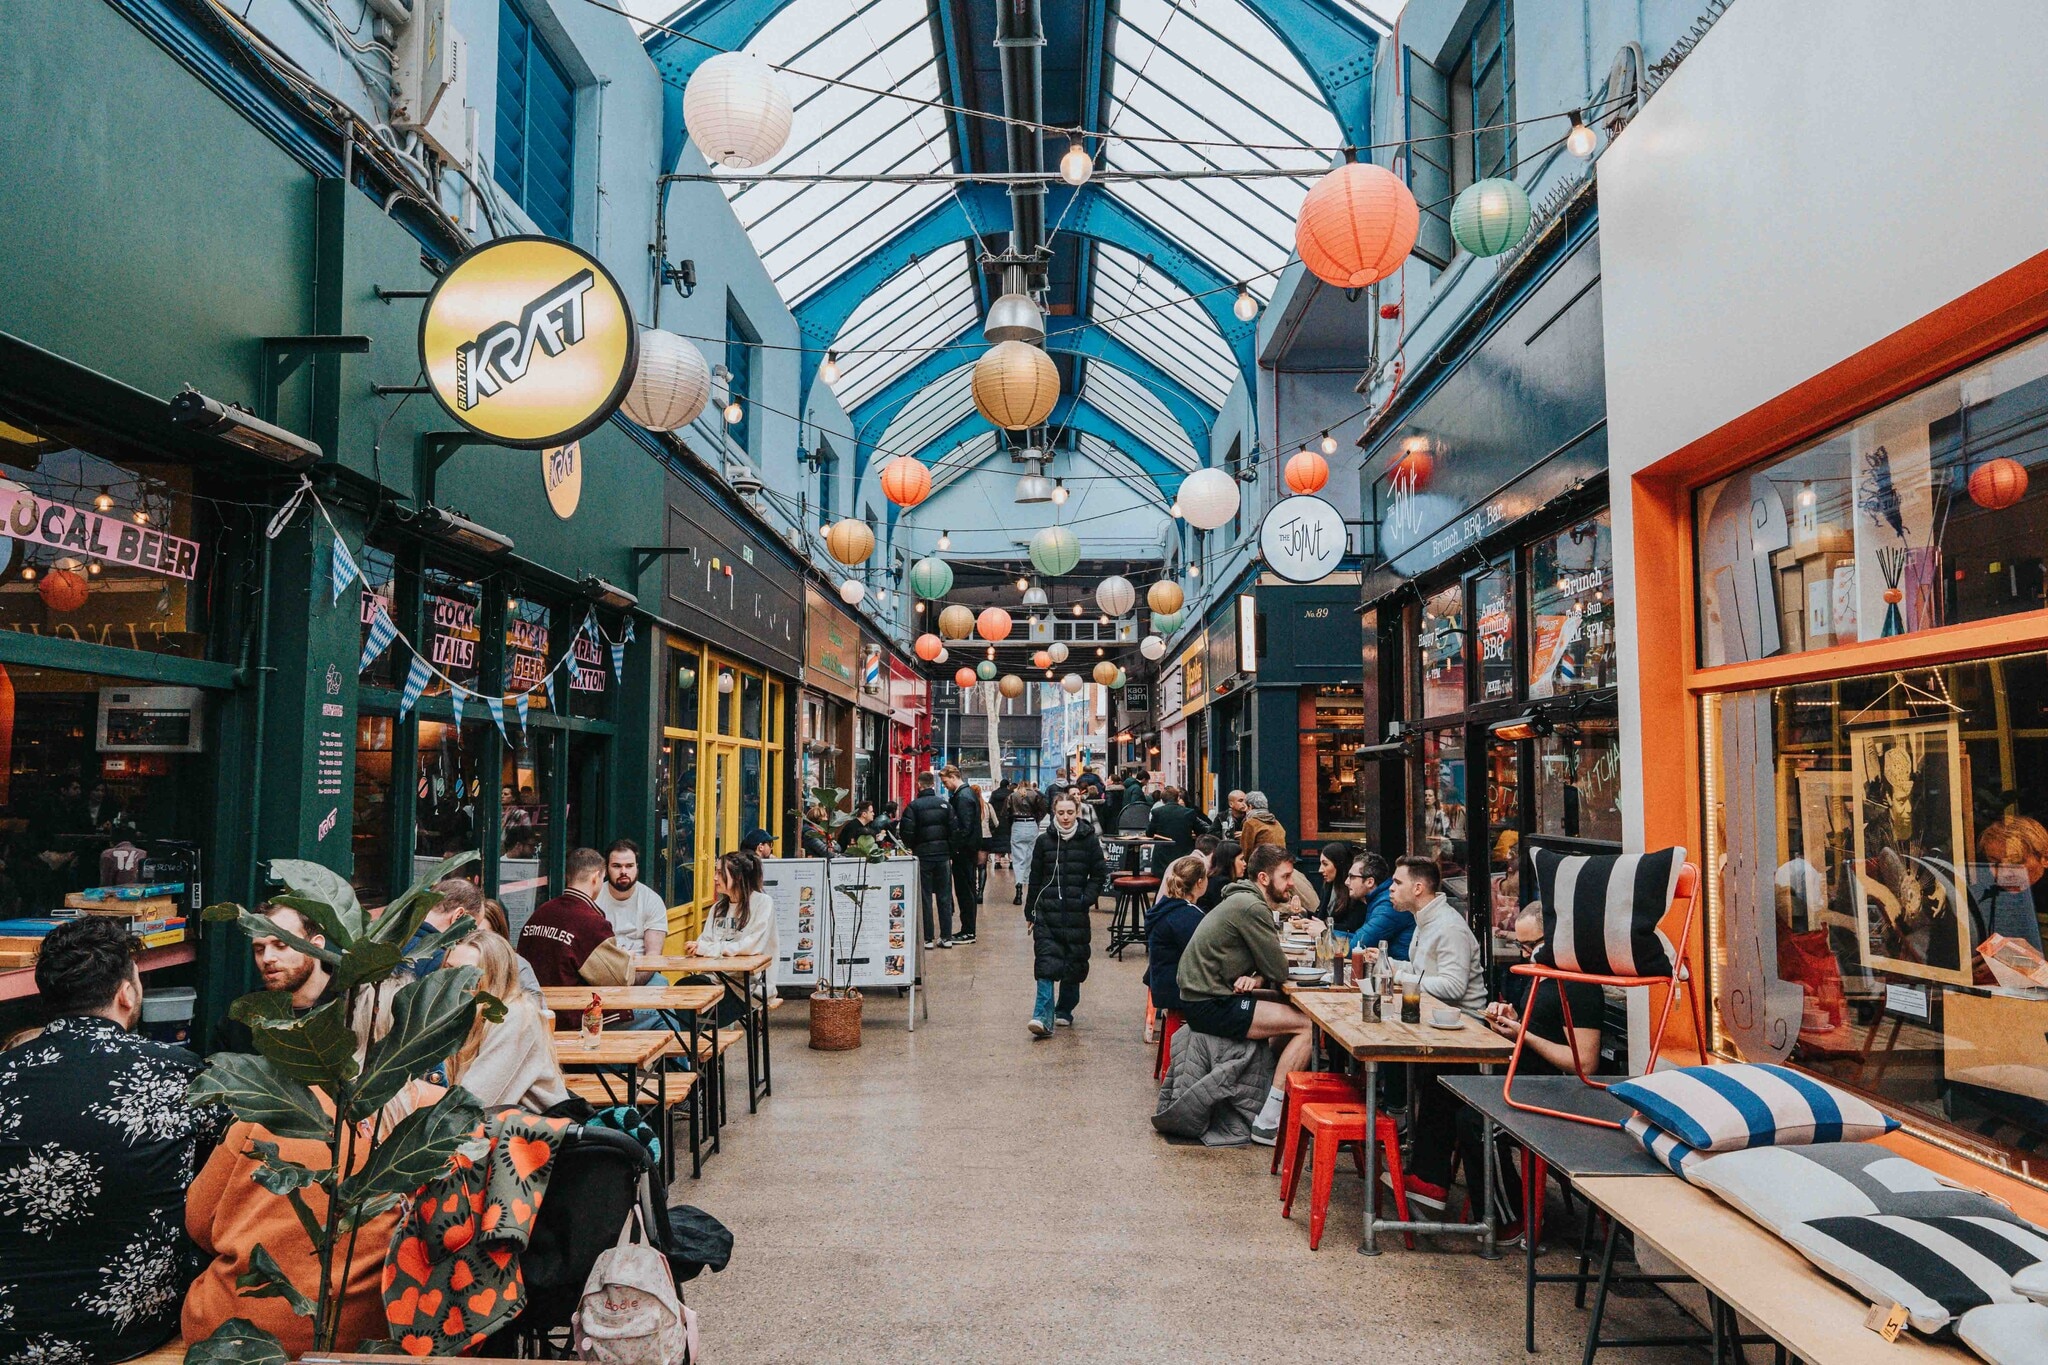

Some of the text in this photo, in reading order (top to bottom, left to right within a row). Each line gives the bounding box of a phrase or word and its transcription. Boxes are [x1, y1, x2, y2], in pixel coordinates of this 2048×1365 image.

[464, 268, 594, 411] KRAFT
[457, 350, 467, 410] BRIXTON
[550, 443, 577, 491] KRAFT
[0, 499, 198, 577] OCAL BEER
[1563, 567, 1603, 598] Brunch
[437, 599, 474, 631] COCK
[1480, 596, 1505, 619] Award
[1587, 602, 1602, 617] Sun
[1479, 614, 1509, 637] winning
[436, 637, 473, 666] TAILS
[1483, 634, 1506, 661] BBQ
[522, 924, 575, 946] SEMINOLES
